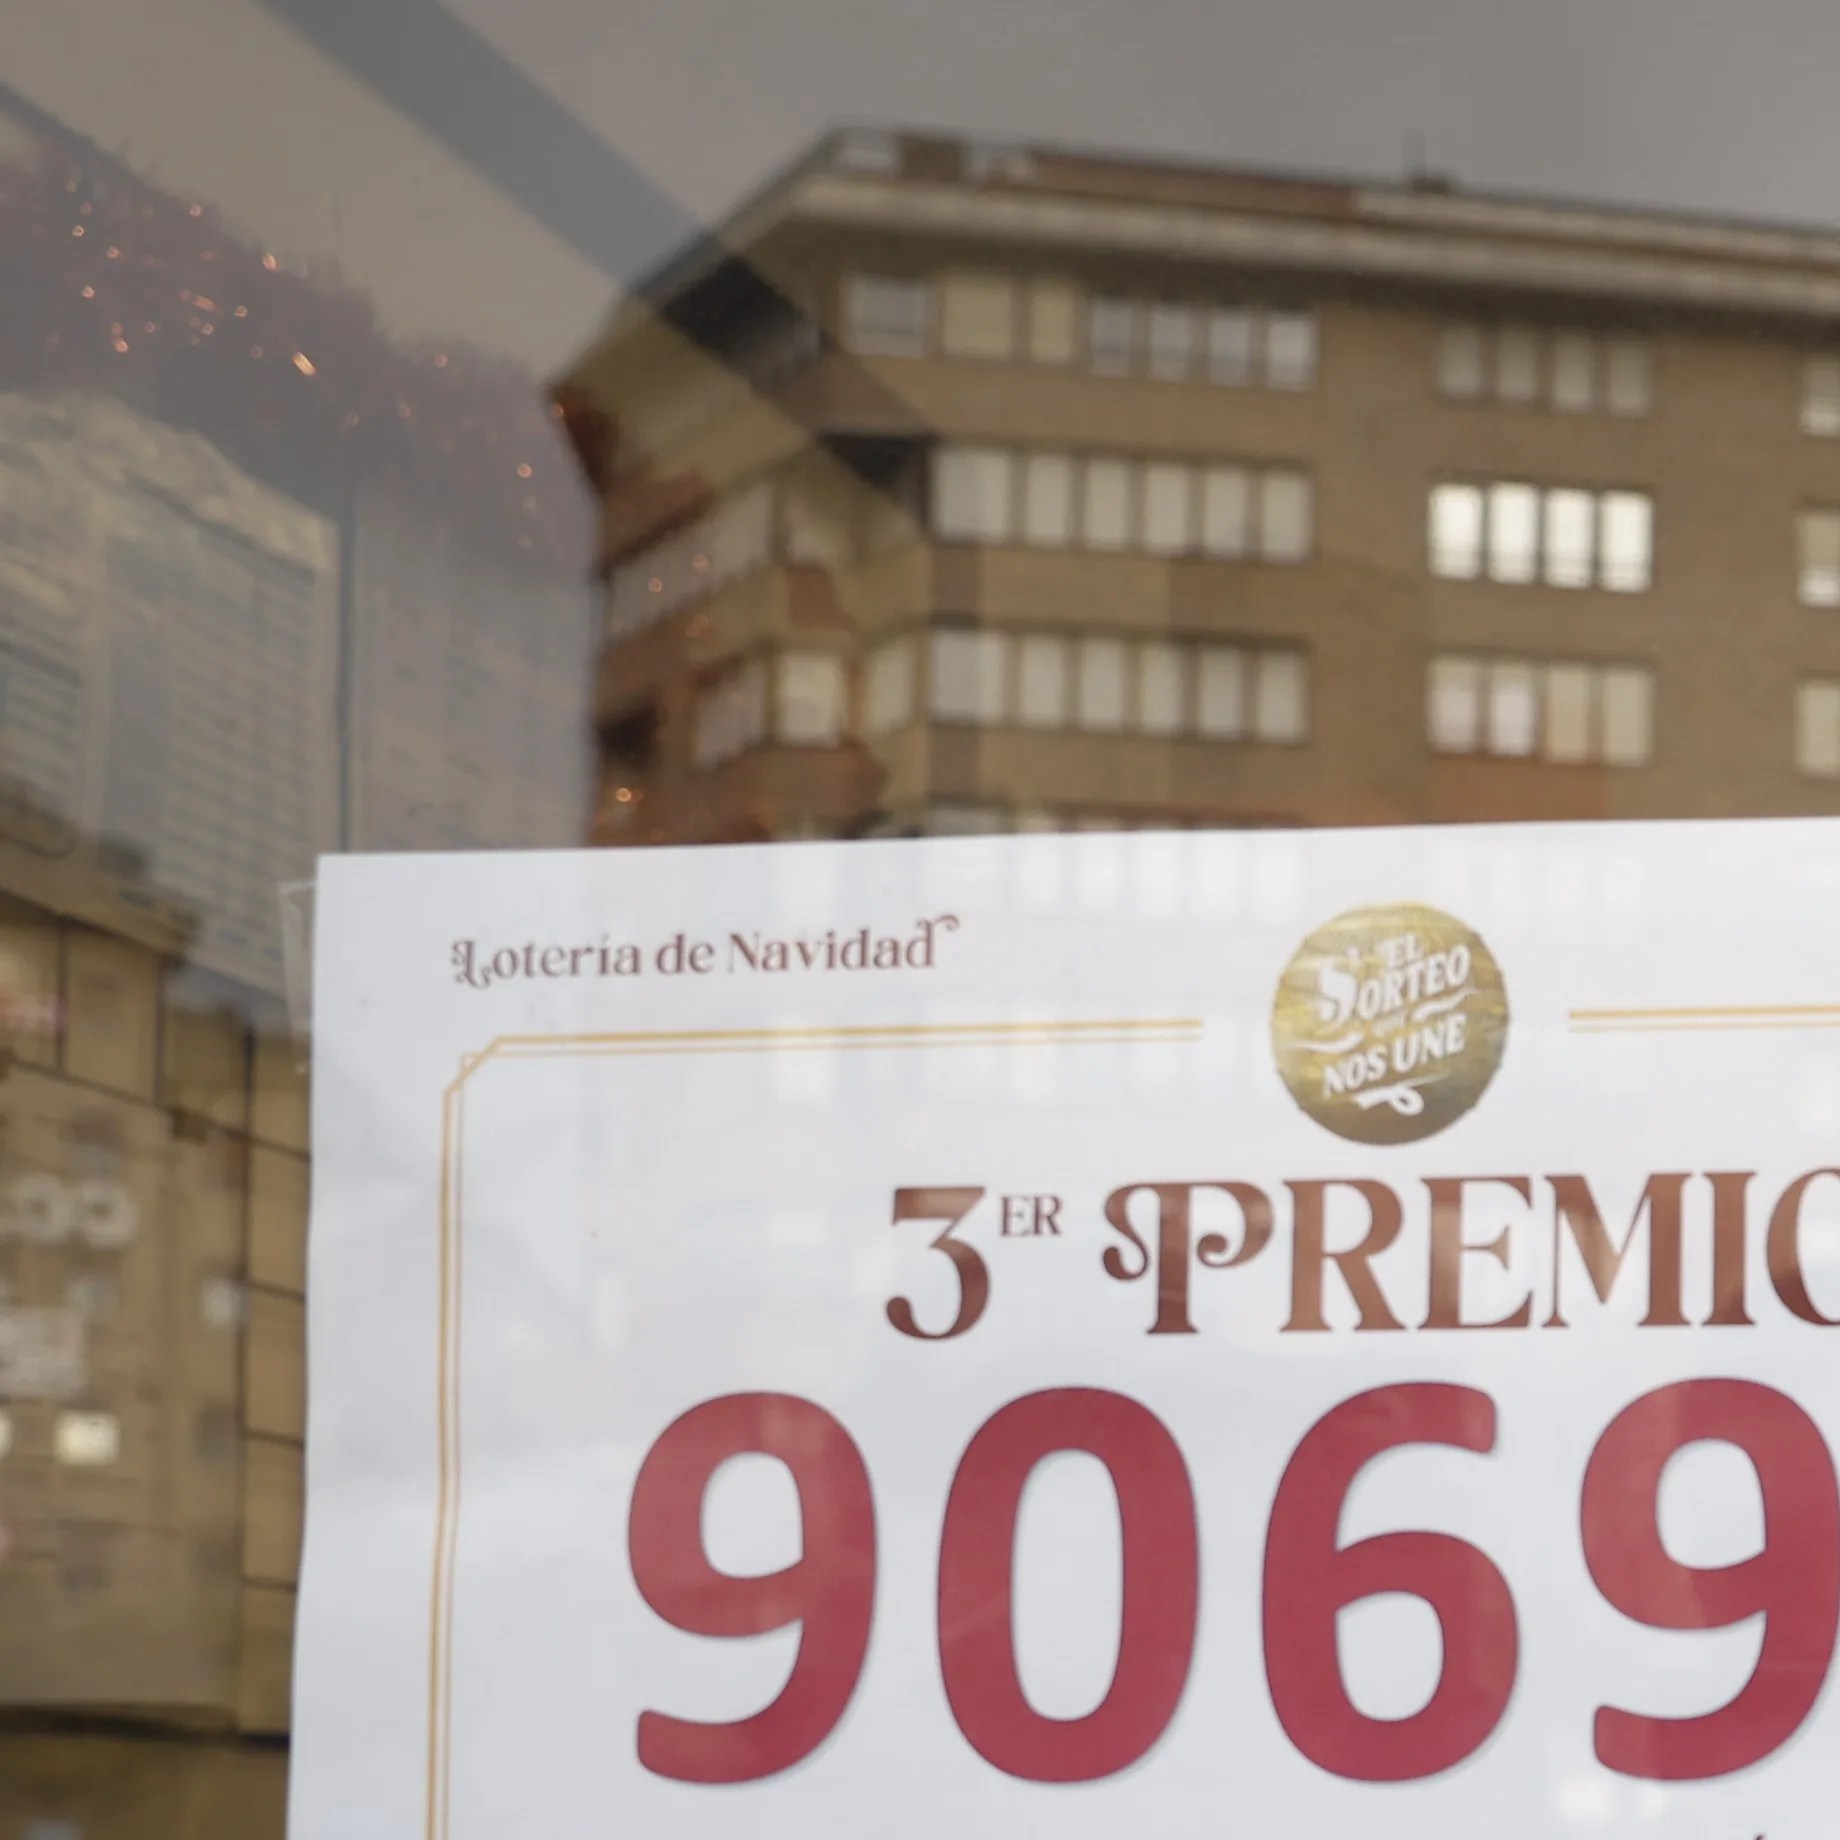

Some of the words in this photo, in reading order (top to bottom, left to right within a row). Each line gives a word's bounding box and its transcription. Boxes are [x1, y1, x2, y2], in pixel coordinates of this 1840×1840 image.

[450, 932, 642, 989] Lotería
[655, 932, 714, 976] de
[728, 913, 960, 973] Navidad
[1322, 1044, 1387, 1099] NOS
[1392, 1012, 1467, 1073] UNE
